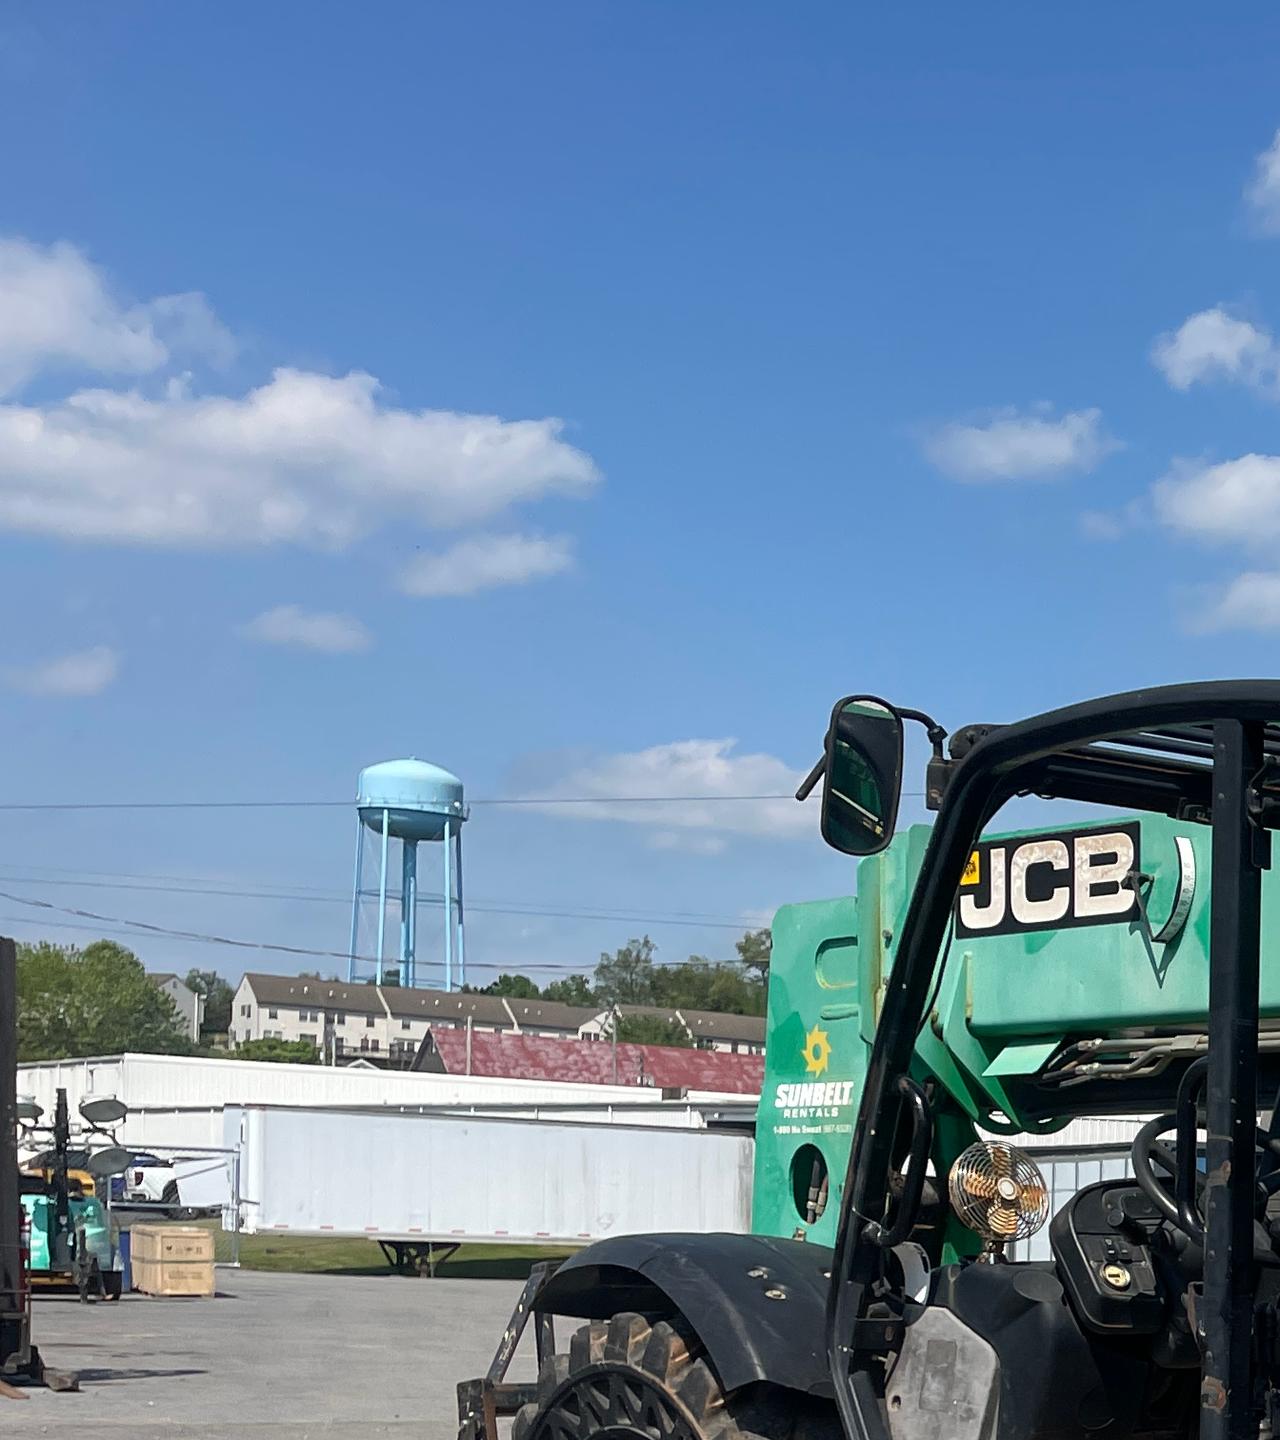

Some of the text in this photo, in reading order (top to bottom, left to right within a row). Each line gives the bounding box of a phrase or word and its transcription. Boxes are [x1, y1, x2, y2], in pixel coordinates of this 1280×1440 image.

[960, 832, 1135, 929] JCB
[775, 1081, 853, 1108] SUNBELT
[784, 1107, 839, 1118] RENTALS
